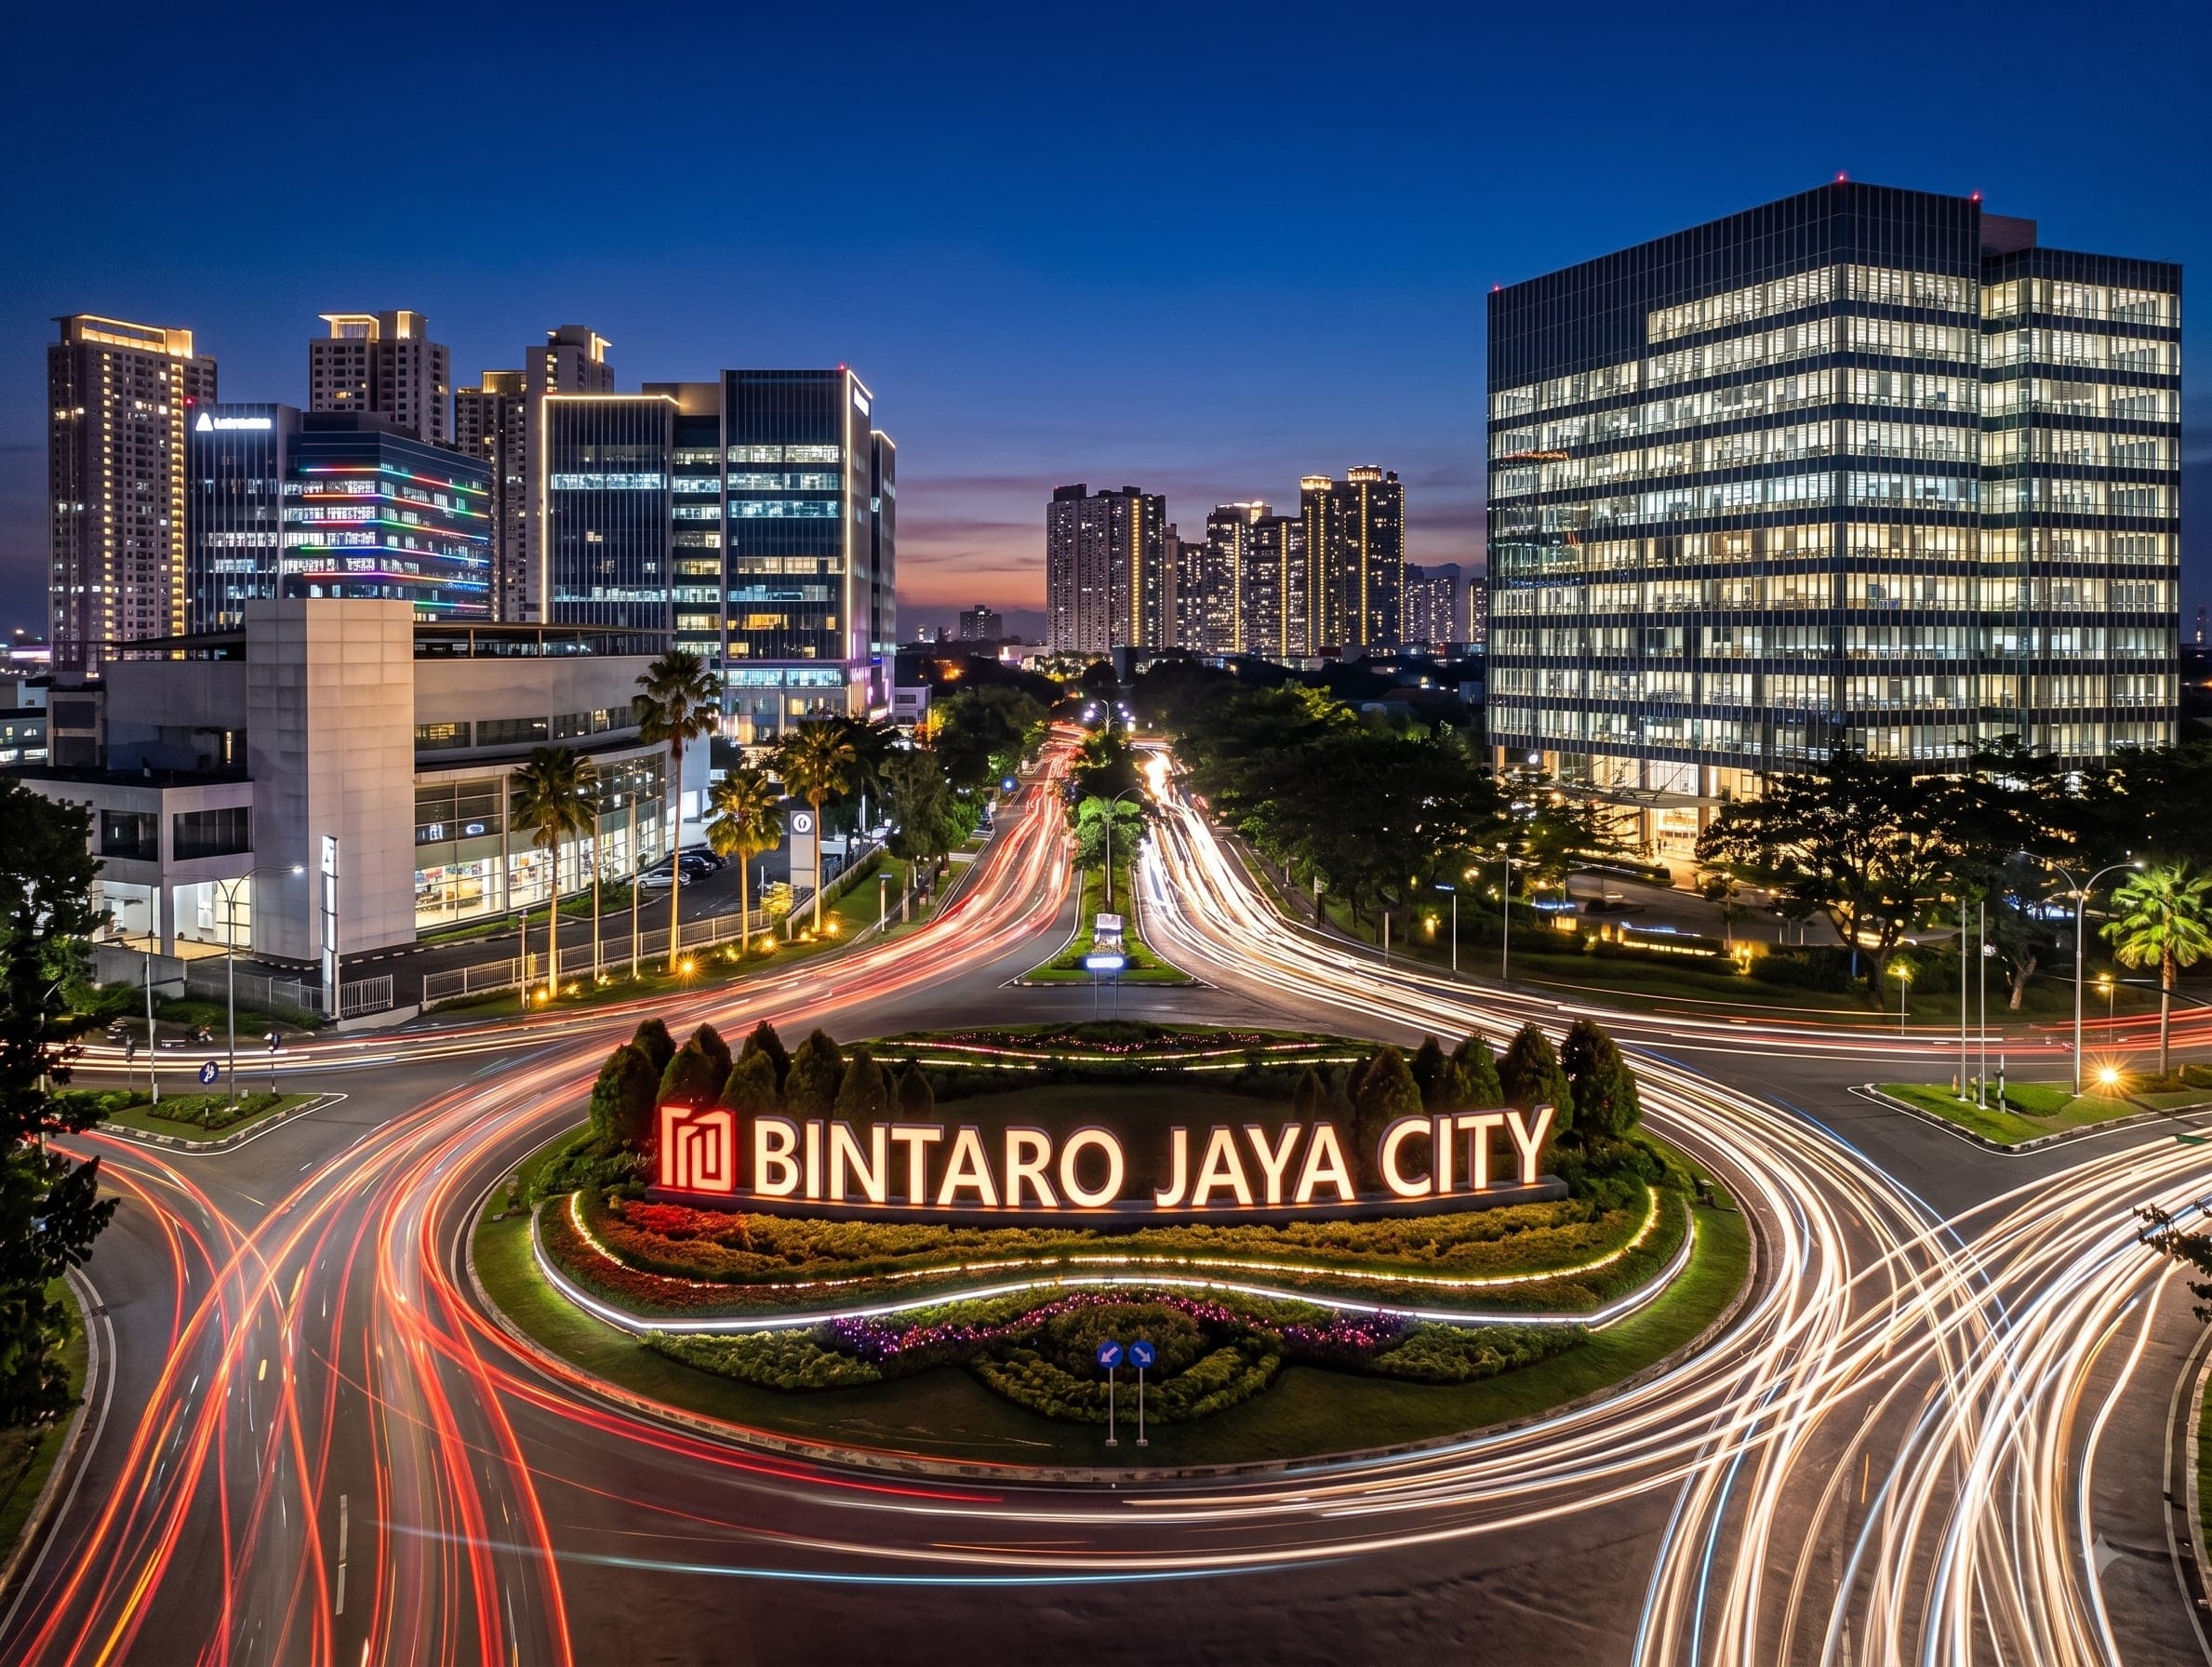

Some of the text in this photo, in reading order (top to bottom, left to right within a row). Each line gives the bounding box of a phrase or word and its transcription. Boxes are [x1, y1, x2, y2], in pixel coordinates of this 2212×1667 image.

[753, 1105, 1554, 1208] BINTARO JAYA CITY
